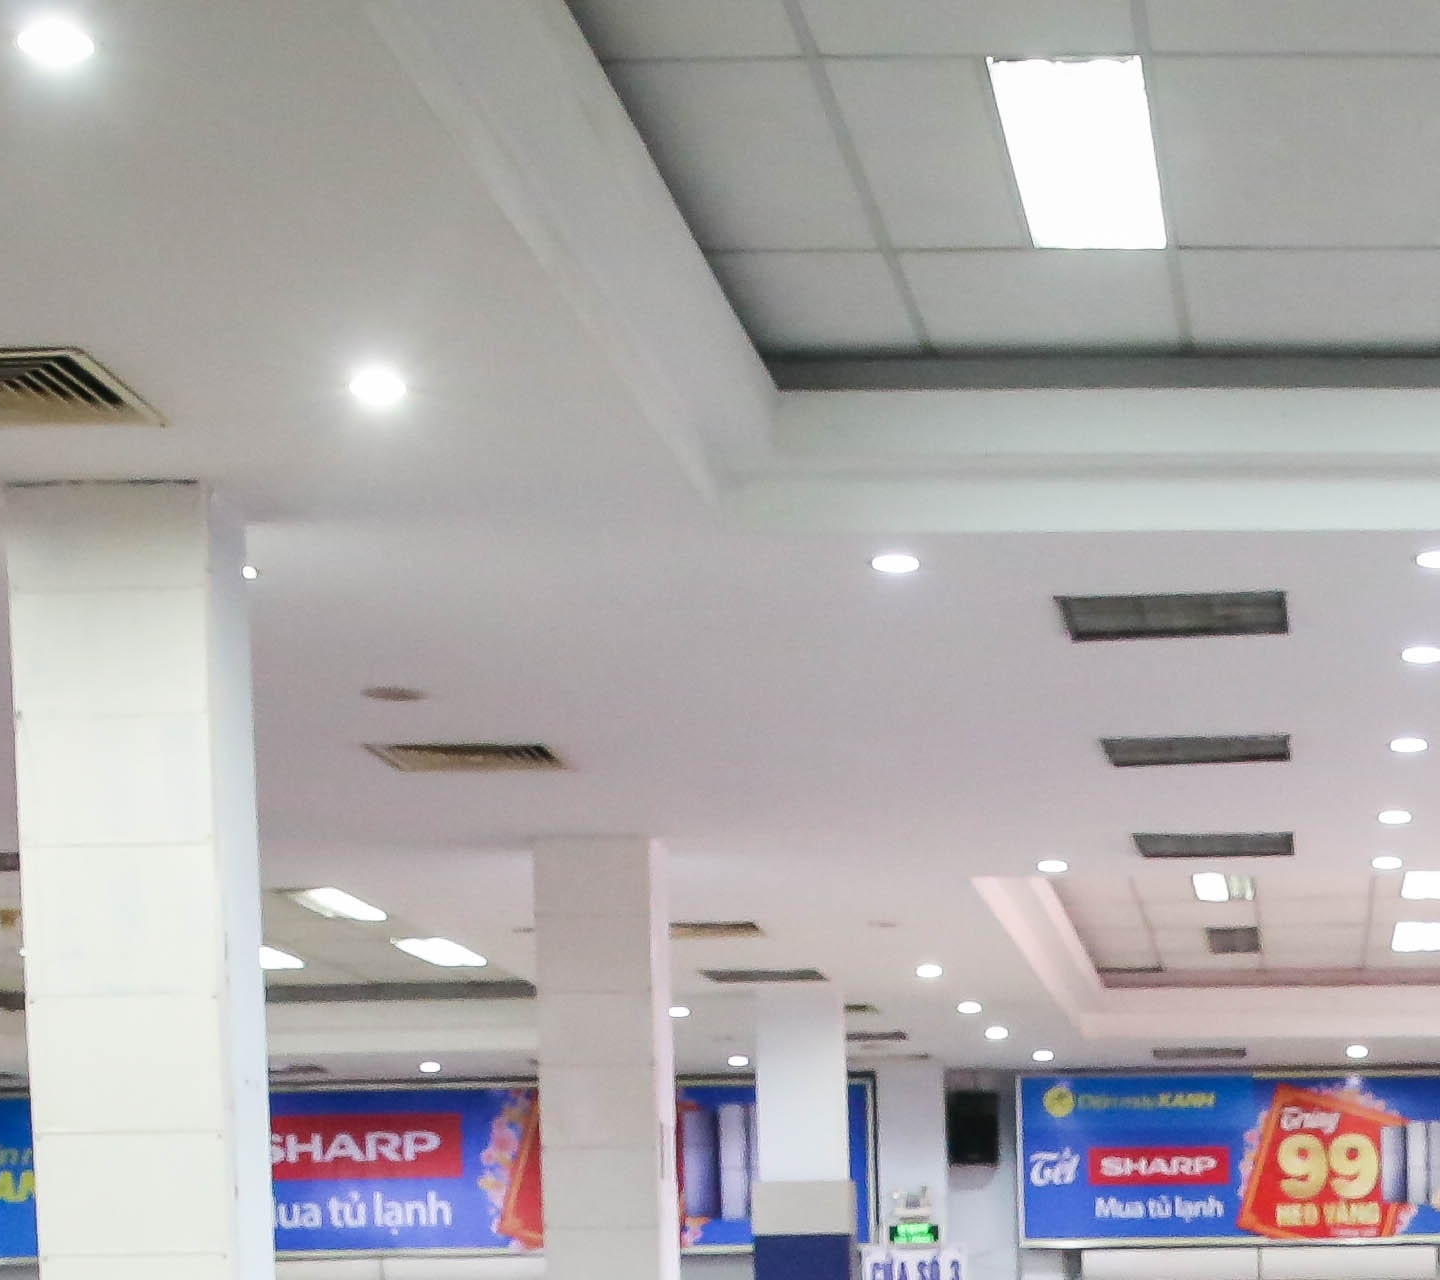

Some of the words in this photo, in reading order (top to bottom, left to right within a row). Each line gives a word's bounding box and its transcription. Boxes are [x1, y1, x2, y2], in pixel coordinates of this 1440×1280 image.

[271, 1129, 442, 1165] SHARP
[1100, 1156, 1217, 1178] SHARP
[1278, 1133, 1381, 1200] 99
[273, 1200, 322, 1229] ua
[328, 1191, 367, 1229] tủ
[373, 1190, 453, 1237] lạnh
[1094, 1196, 1144, 1219] Mua
[1147, 1194, 1171, 1218] tủ
[1173, 1194, 1224, 1222] lạnh
[1275, 1203, 1320, 1226] HEO
[1324, 1200, 1381, 1225] VÀNG
